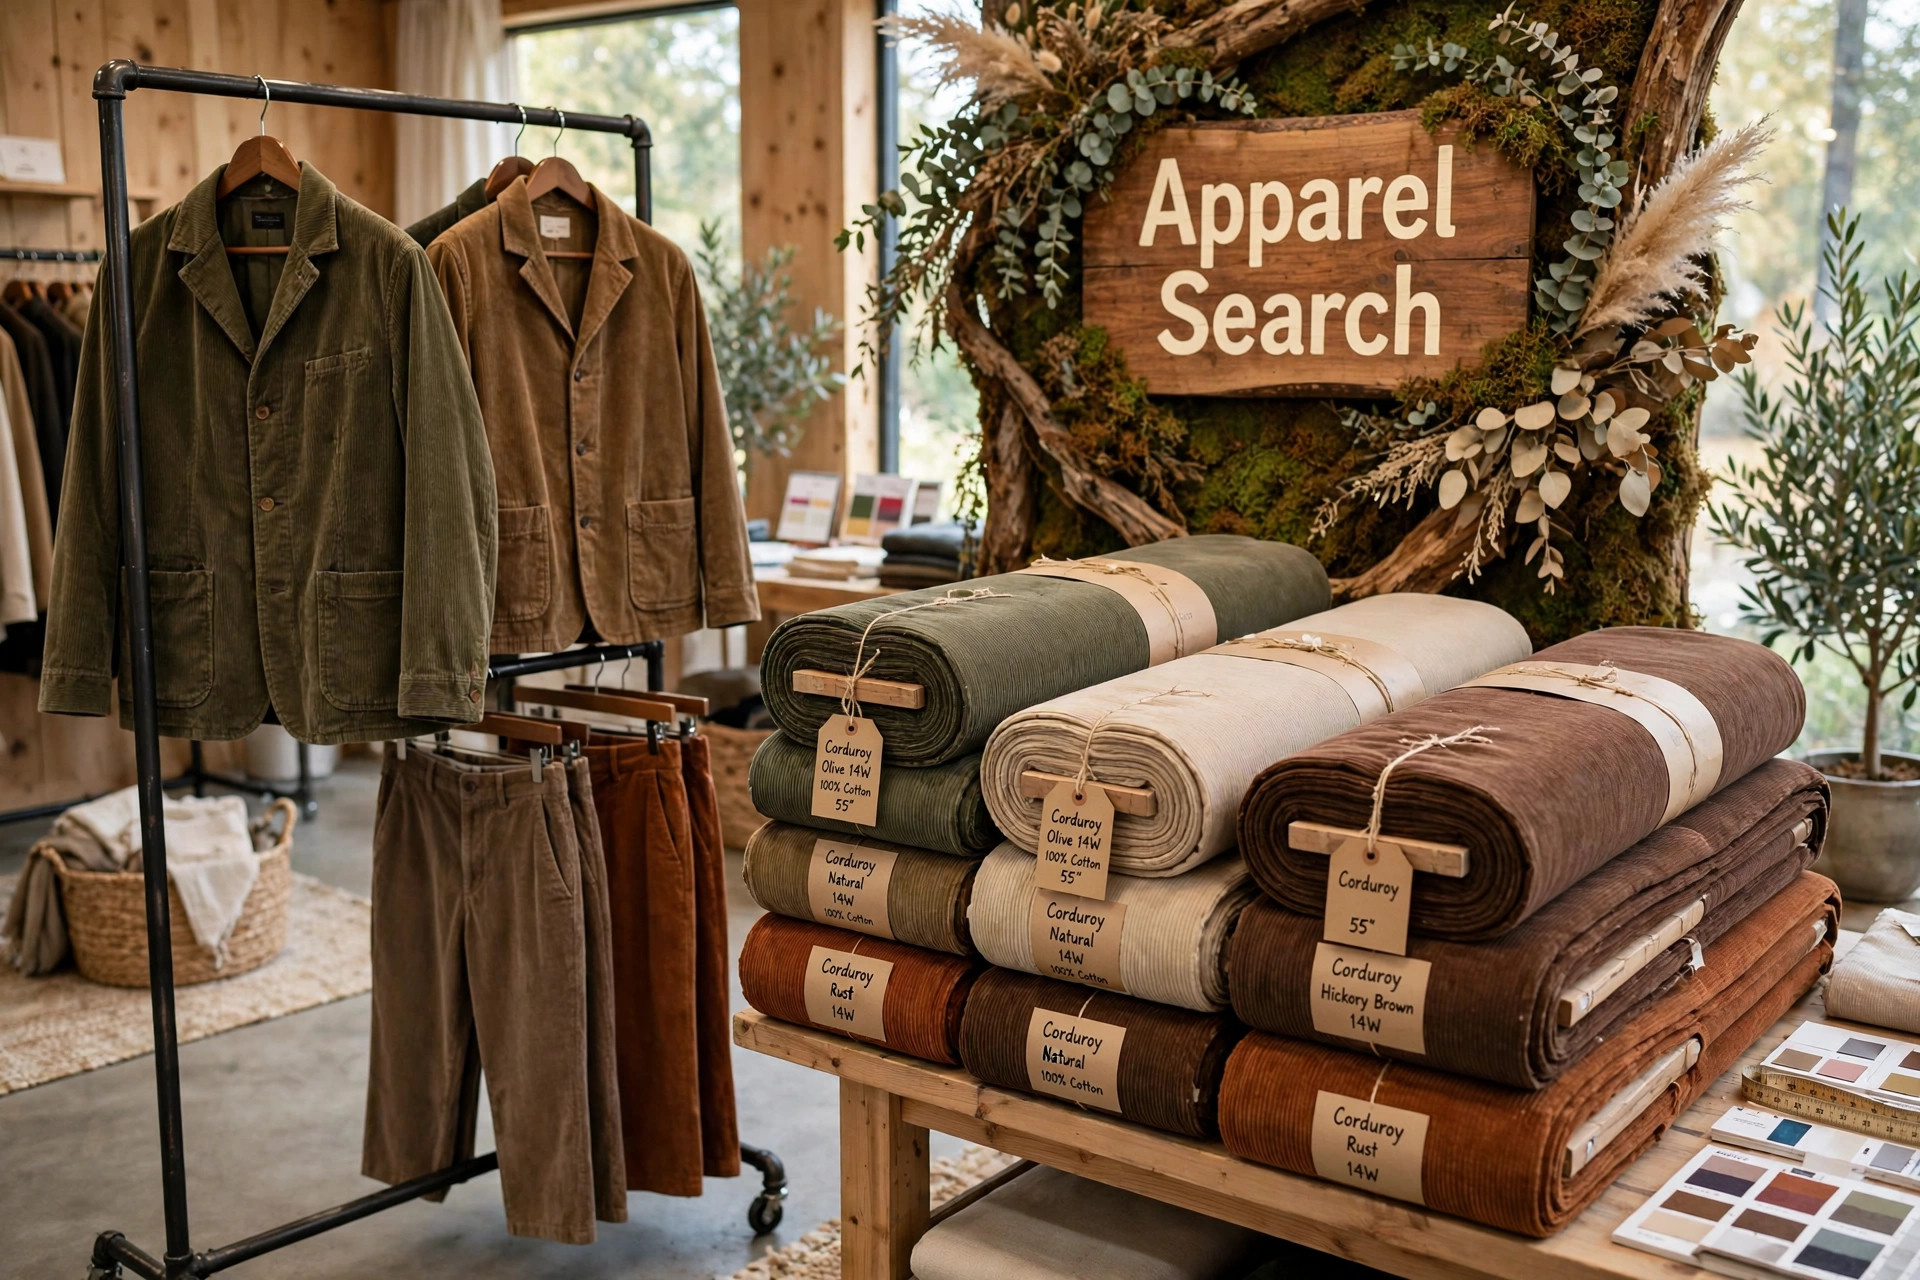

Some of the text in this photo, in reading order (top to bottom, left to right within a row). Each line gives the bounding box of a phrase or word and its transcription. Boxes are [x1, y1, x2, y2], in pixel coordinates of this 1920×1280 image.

[1139, 145, 1456, 268] Apparel
[1157, 264, 1441, 356] Search
[825, 739, 872, 764] Corduroy
[822, 760, 871, 778] Olive 14W
[820, 780, 871, 797] 100% Cotton
[835, 799, 854, 811] 55"
[1051, 808, 1102, 836] Corduroy
[1047, 830, 1101, 850] Olive 14W
[826, 850, 876, 877] Corduroy
[1045, 850, 1100, 870] 100% Cotton
[828, 871, 864, 890] Natural
[1061, 869, 1081, 884] 55"
[1339, 870, 1399, 902] Corduroy
[833, 892, 854, 906] 14W
[824, 908, 874, 926] 100% Cotton
[1047, 902, 1105, 932] Corduroy
[1349, 917, 1375, 934] 55"
[1050, 926, 1094, 947] Natural
[1059, 949, 1084, 965] 14W
[822, 958, 874, 988] Corduroy
[1050, 964, 1108, 984] 100% Cotton
[1332, 958, 1402, 992] Corduroy
[830, 982, 854, 1000] Rust
[1321, 983, 1414, 1014] Hickory Brown
[832, 1005, 854, 1021] 14W
[1350, 1014, 1381, 1033] 14W
[1043, 1021, 1103, 1055] Corduroy
[1042, 1045, 1085, 1069] Natural
[1041, 1070, 1103, 1095] 100% Cotton
[1333, 1106, 1404, 1146] Corduroy
[1347, 1135, 1378, 1158] Rust
[1347, 1161, 1379, 1182] 14W
